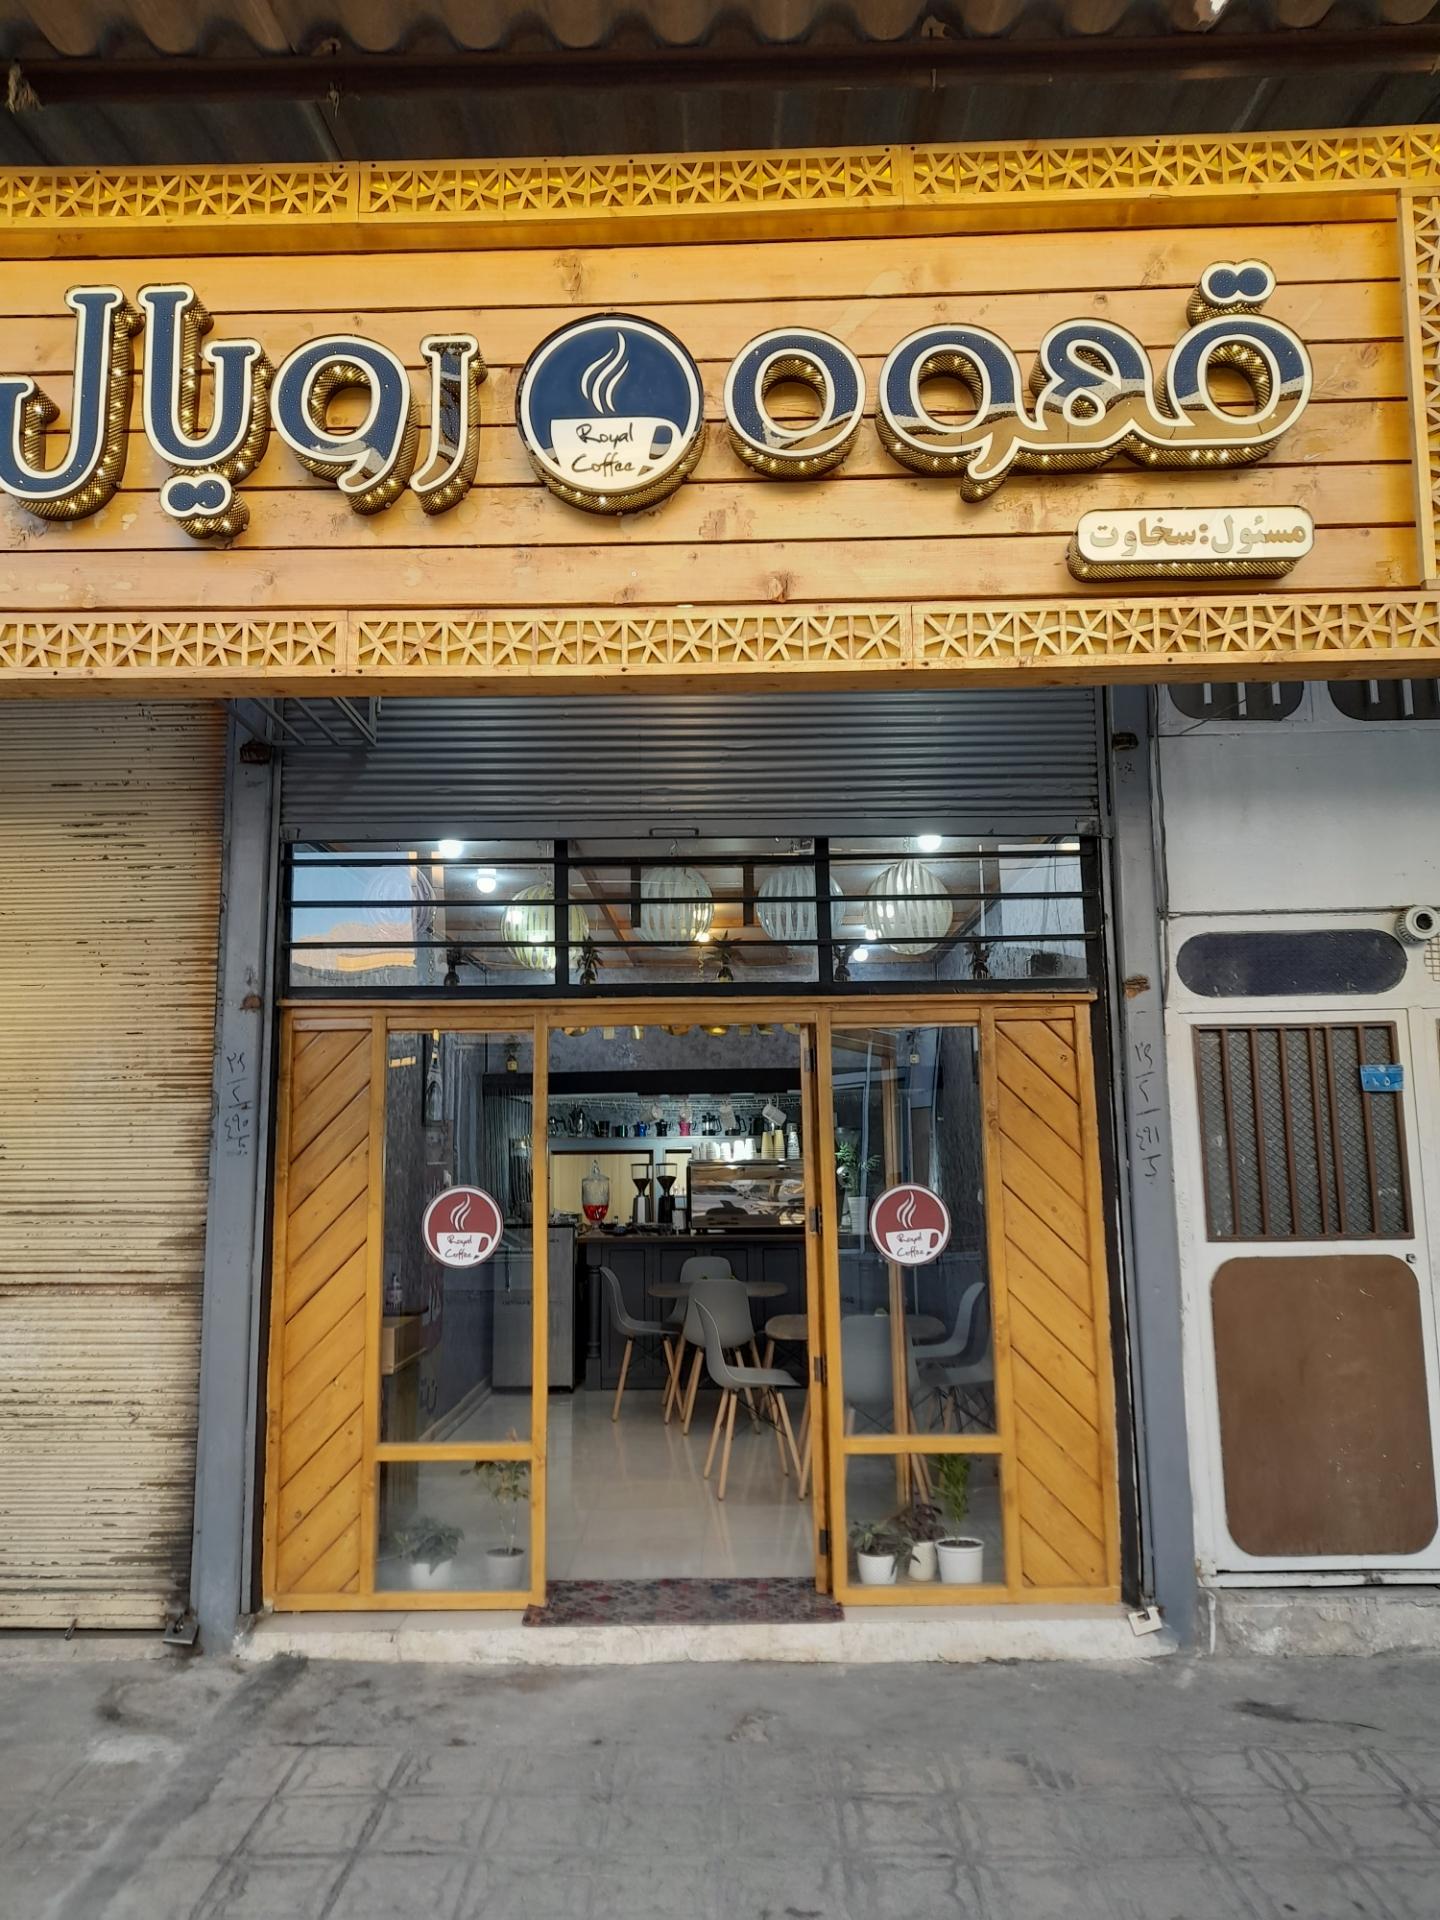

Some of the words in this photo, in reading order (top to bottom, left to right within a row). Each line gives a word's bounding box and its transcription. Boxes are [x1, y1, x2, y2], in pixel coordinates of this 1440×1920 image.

[723, 259, 1314, 482] قهوه
[576, 422, 634, 448] Royal
[571, 452, 636, 477] Coffee
[446, 1234, 472, 1247] Royal
[896, 1232, 922, 1244] Royal
[444, 1248, 472, 1260] Coffee
[896, 1246, 925, 1258] Coffee
